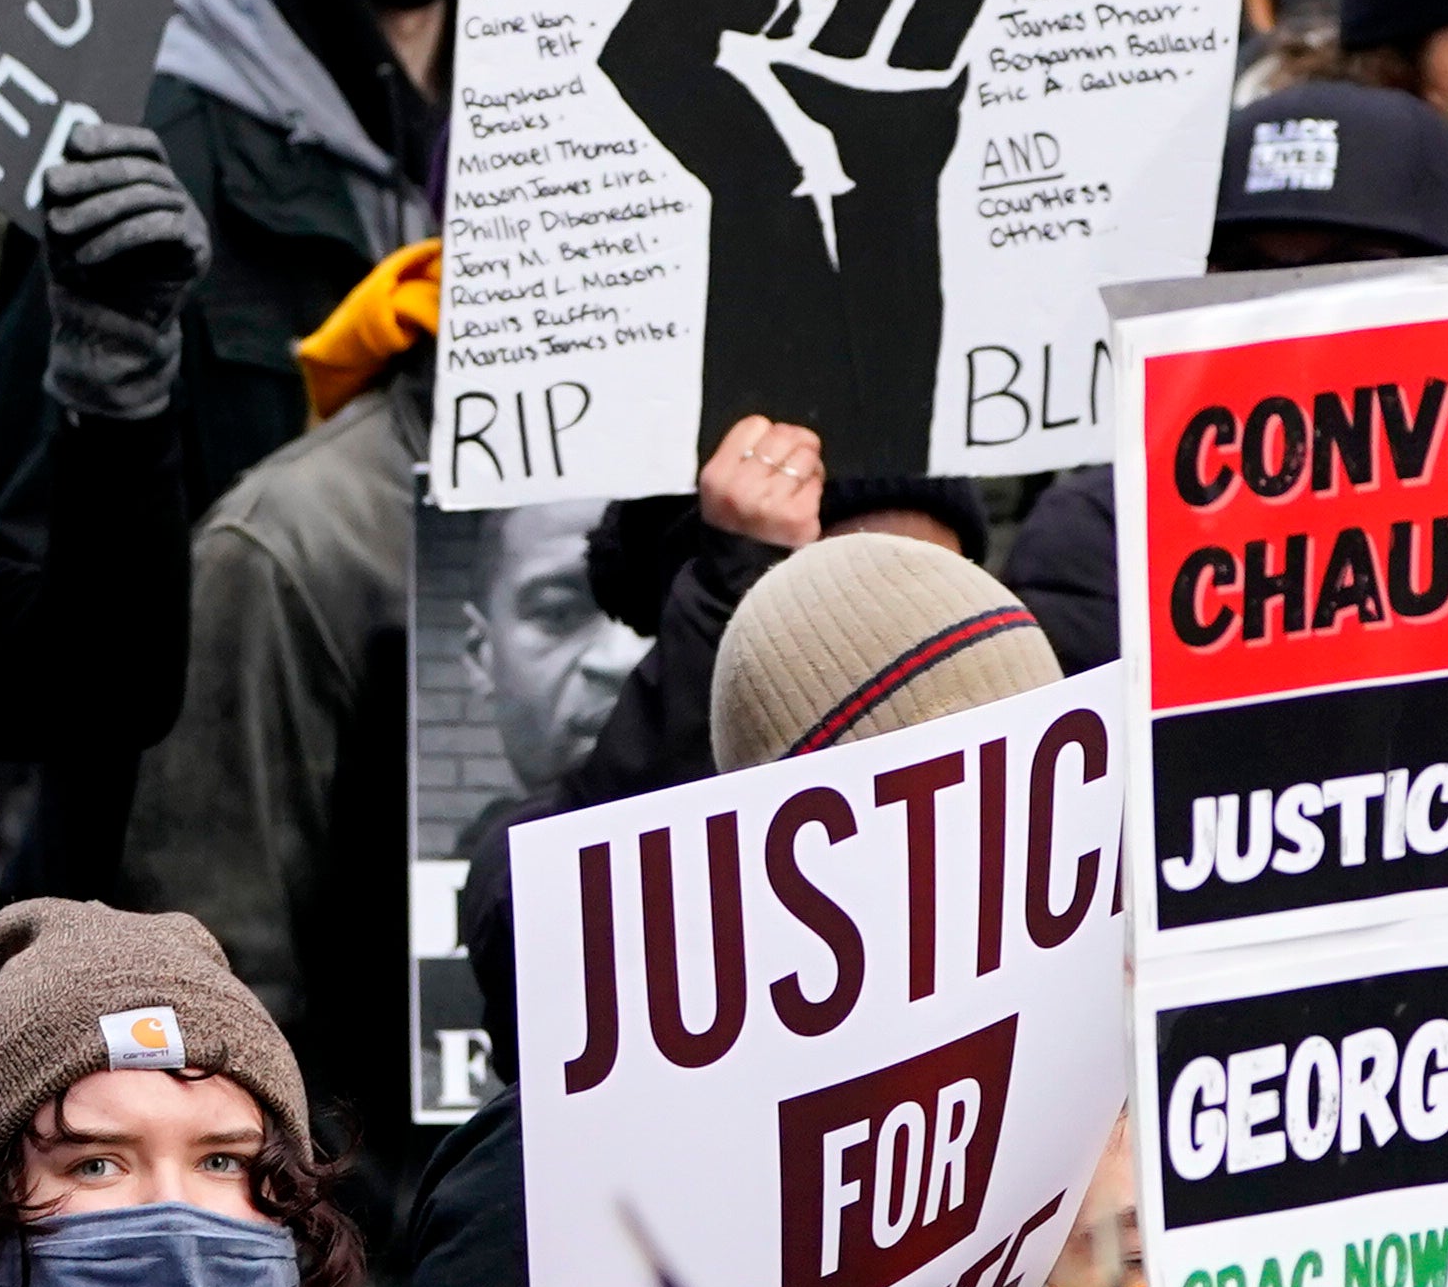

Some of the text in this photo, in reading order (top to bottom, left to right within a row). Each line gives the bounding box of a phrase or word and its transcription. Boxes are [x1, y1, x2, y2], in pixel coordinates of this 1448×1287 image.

[983, 131, 1063, 180] AND
[978, 183, 1111, 219] countless
[990, 218, 1091, 248] others
[450, 381, 592, 489] RIP
[564, 706, 1123, 1097] JUSTIC
[123, 1049, 169, 1060] carhartt
[819, 1074, 984, 1277] FOR
